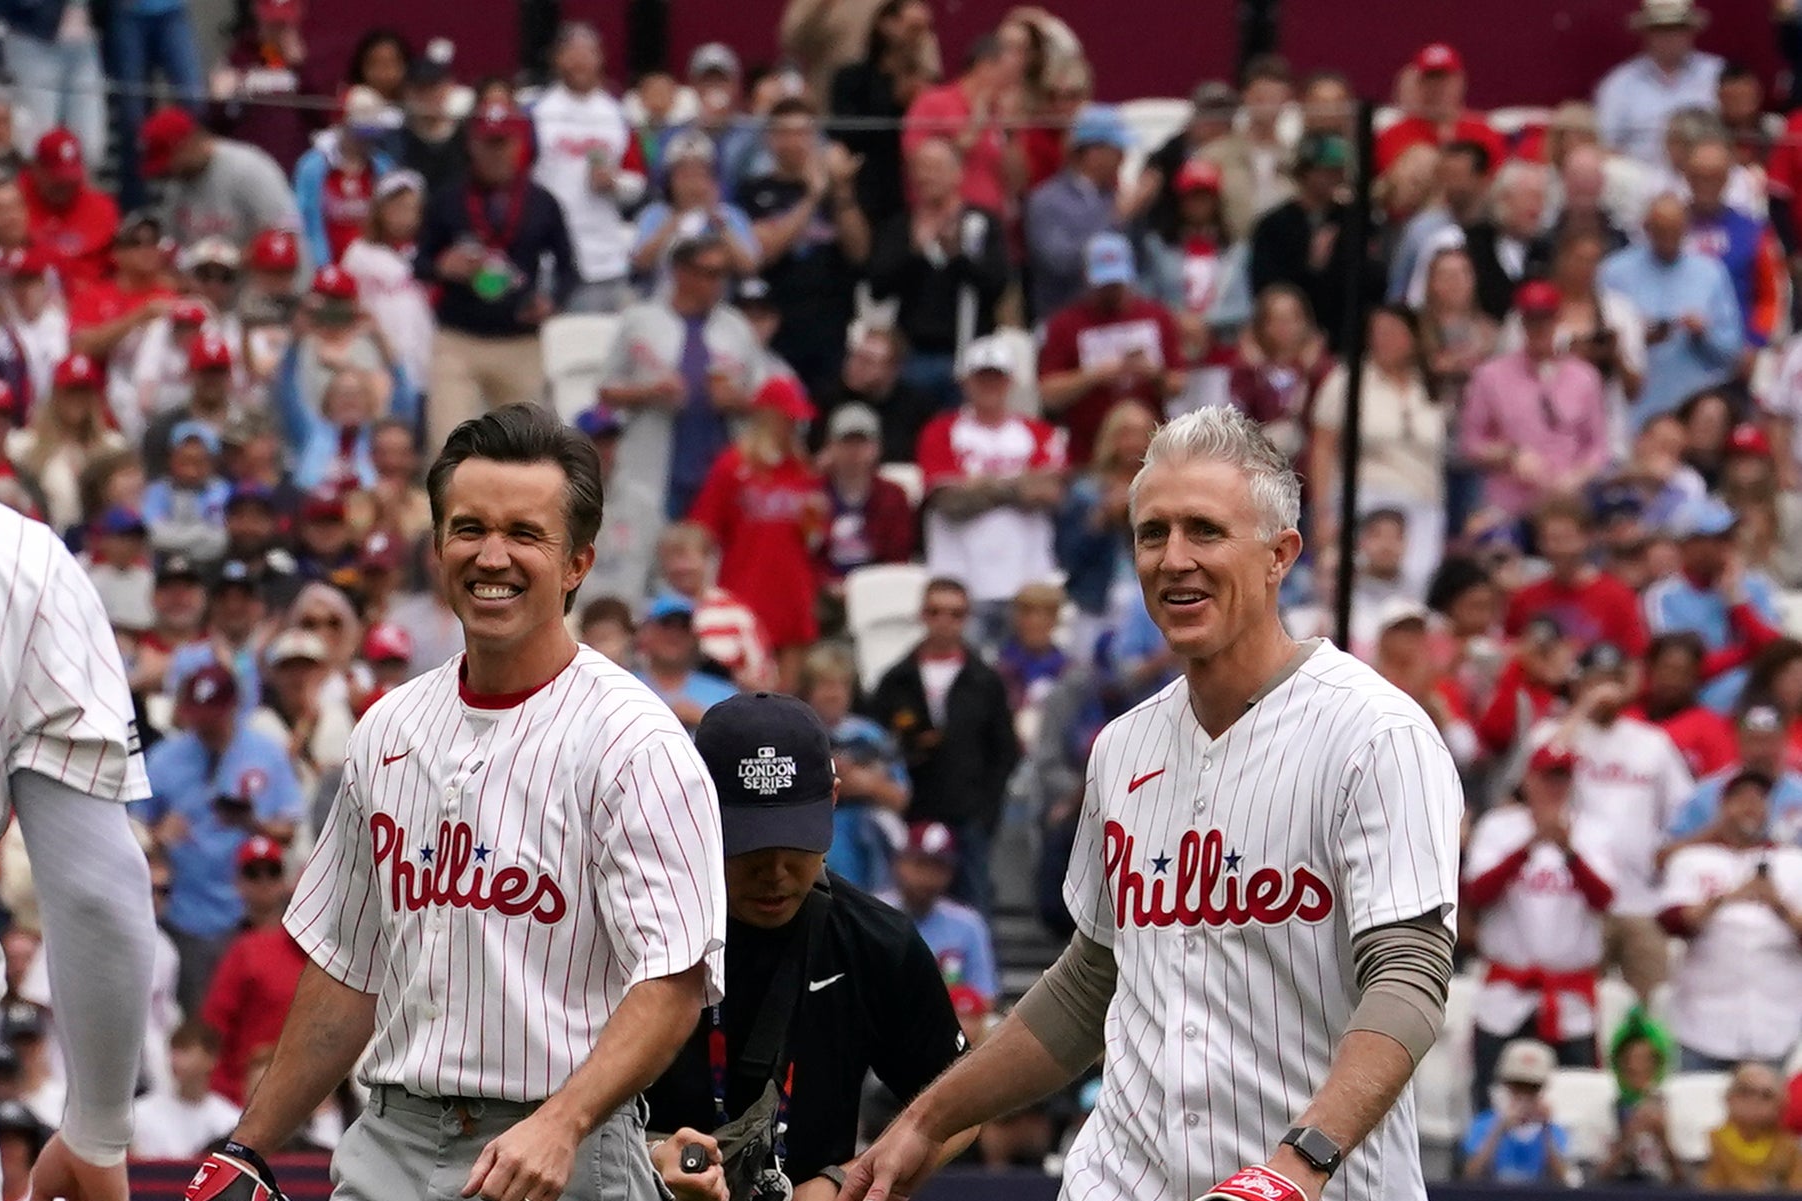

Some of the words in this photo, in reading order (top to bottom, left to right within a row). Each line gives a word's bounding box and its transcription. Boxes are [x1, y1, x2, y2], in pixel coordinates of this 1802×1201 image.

[738, 762, 797, 777] LONDON
[743, 776, 793, 789] SERIES
[370, 812, 568, 925] Phillies
[1104, 820, 1334, 930] Phillies
